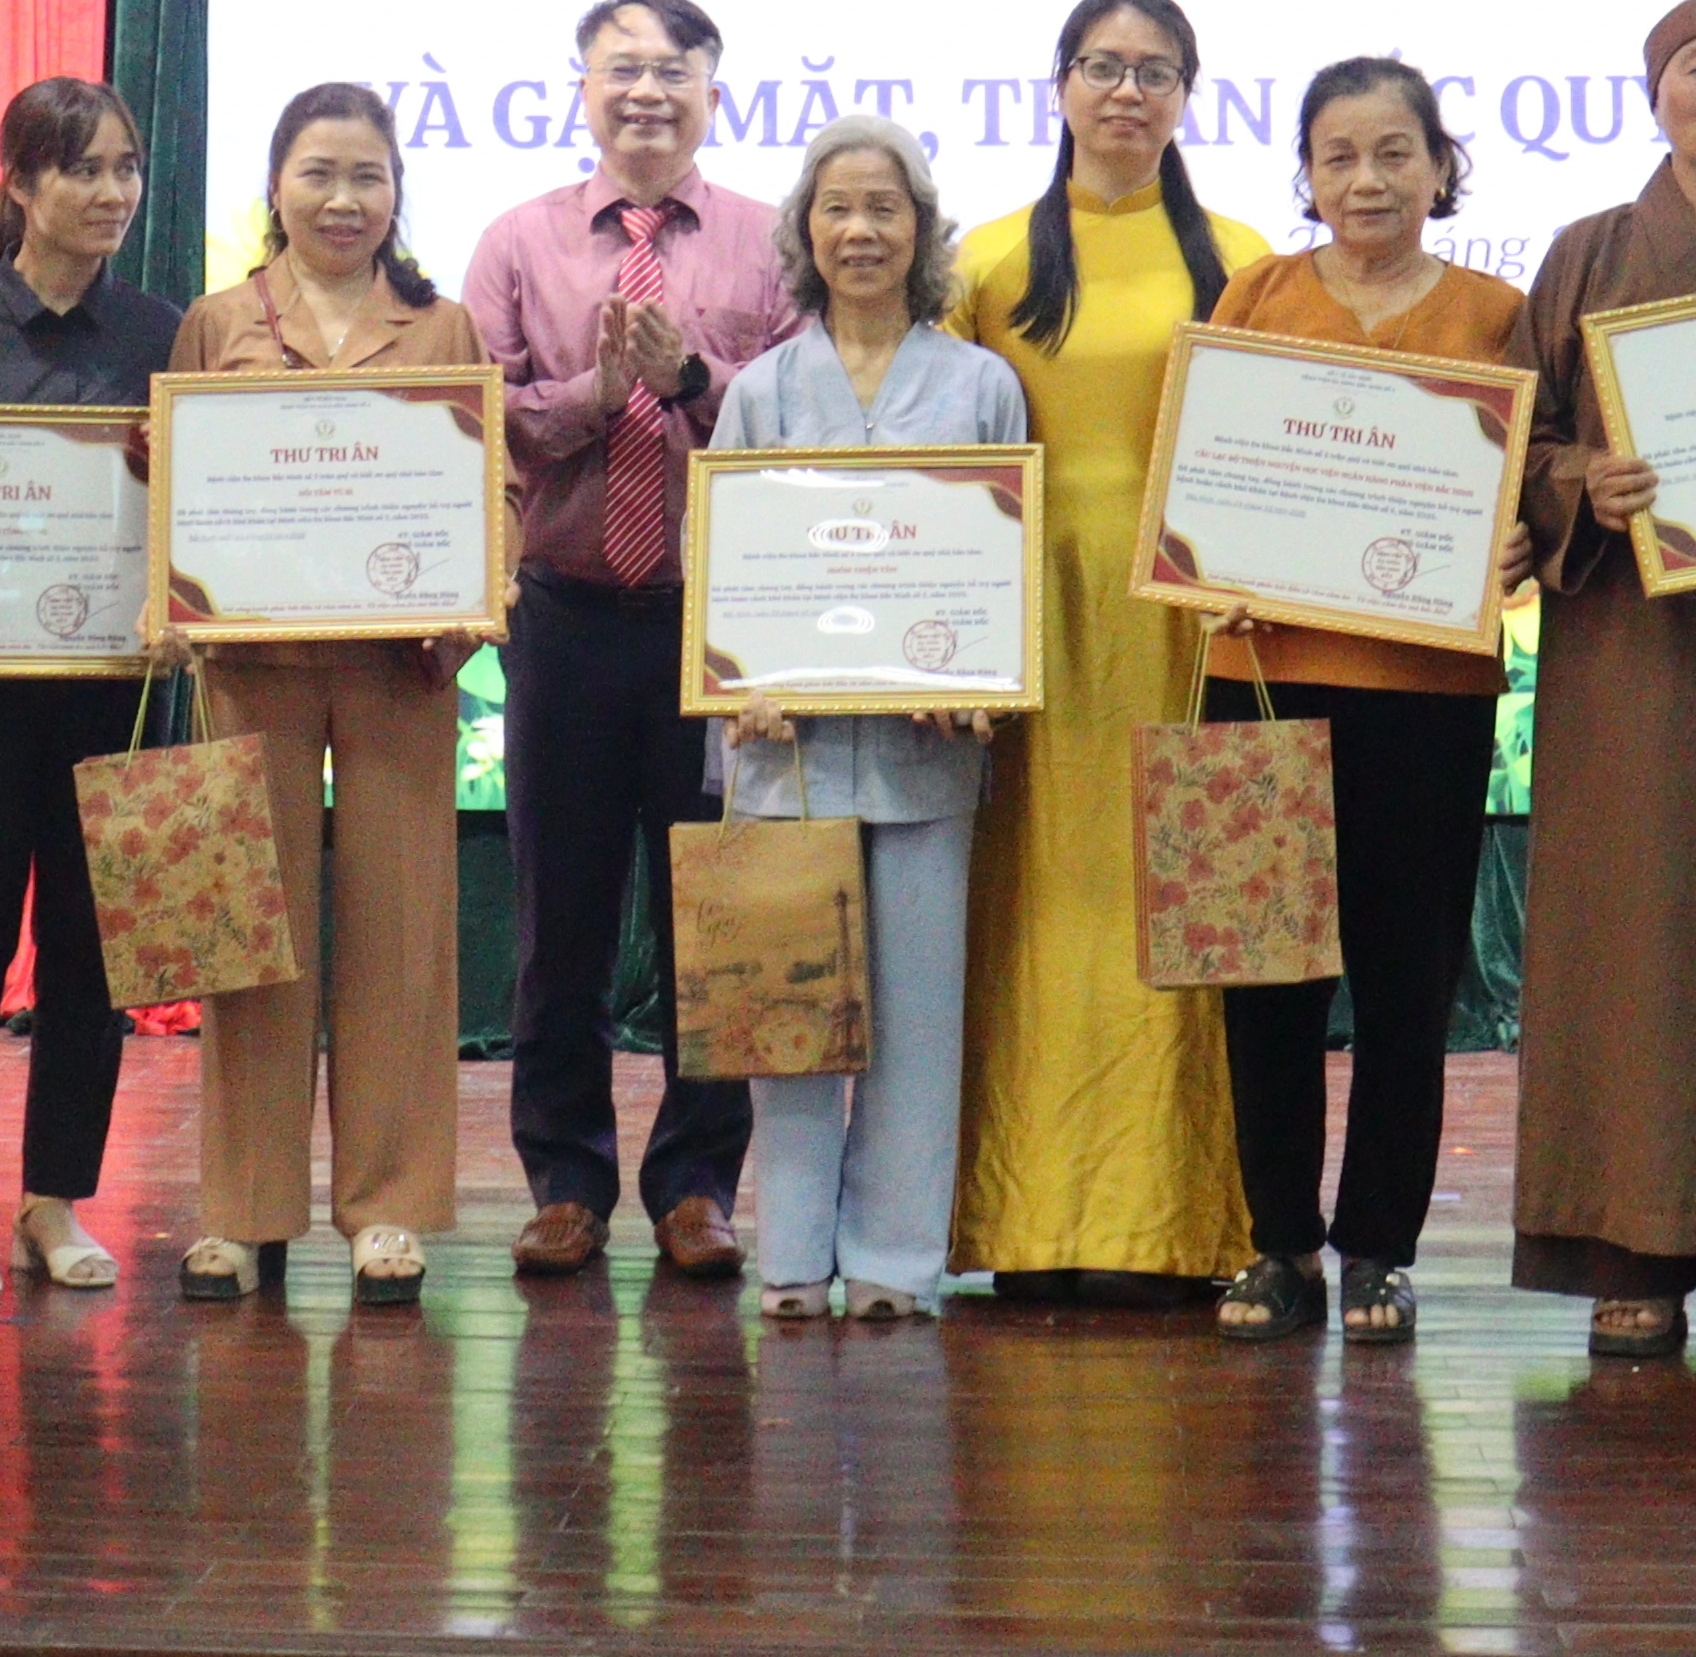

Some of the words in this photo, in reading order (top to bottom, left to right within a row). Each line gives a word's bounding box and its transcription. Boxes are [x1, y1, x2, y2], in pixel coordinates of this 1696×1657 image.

[1432, 226, 1531, 280] áng
[1283, 418, 1328, 439] THƯ
[1329, 424, 1363, 445] TRI
[1365, 425, 1396, 450] ÂN
[270, 446, 312, 464] THƯ
[315, 447, 347, 463] TRI
[351, 440, 379, 462] ÂN
[24, 480, 52, 501] ÂN
[889, 520, 917, 541] ÂN
